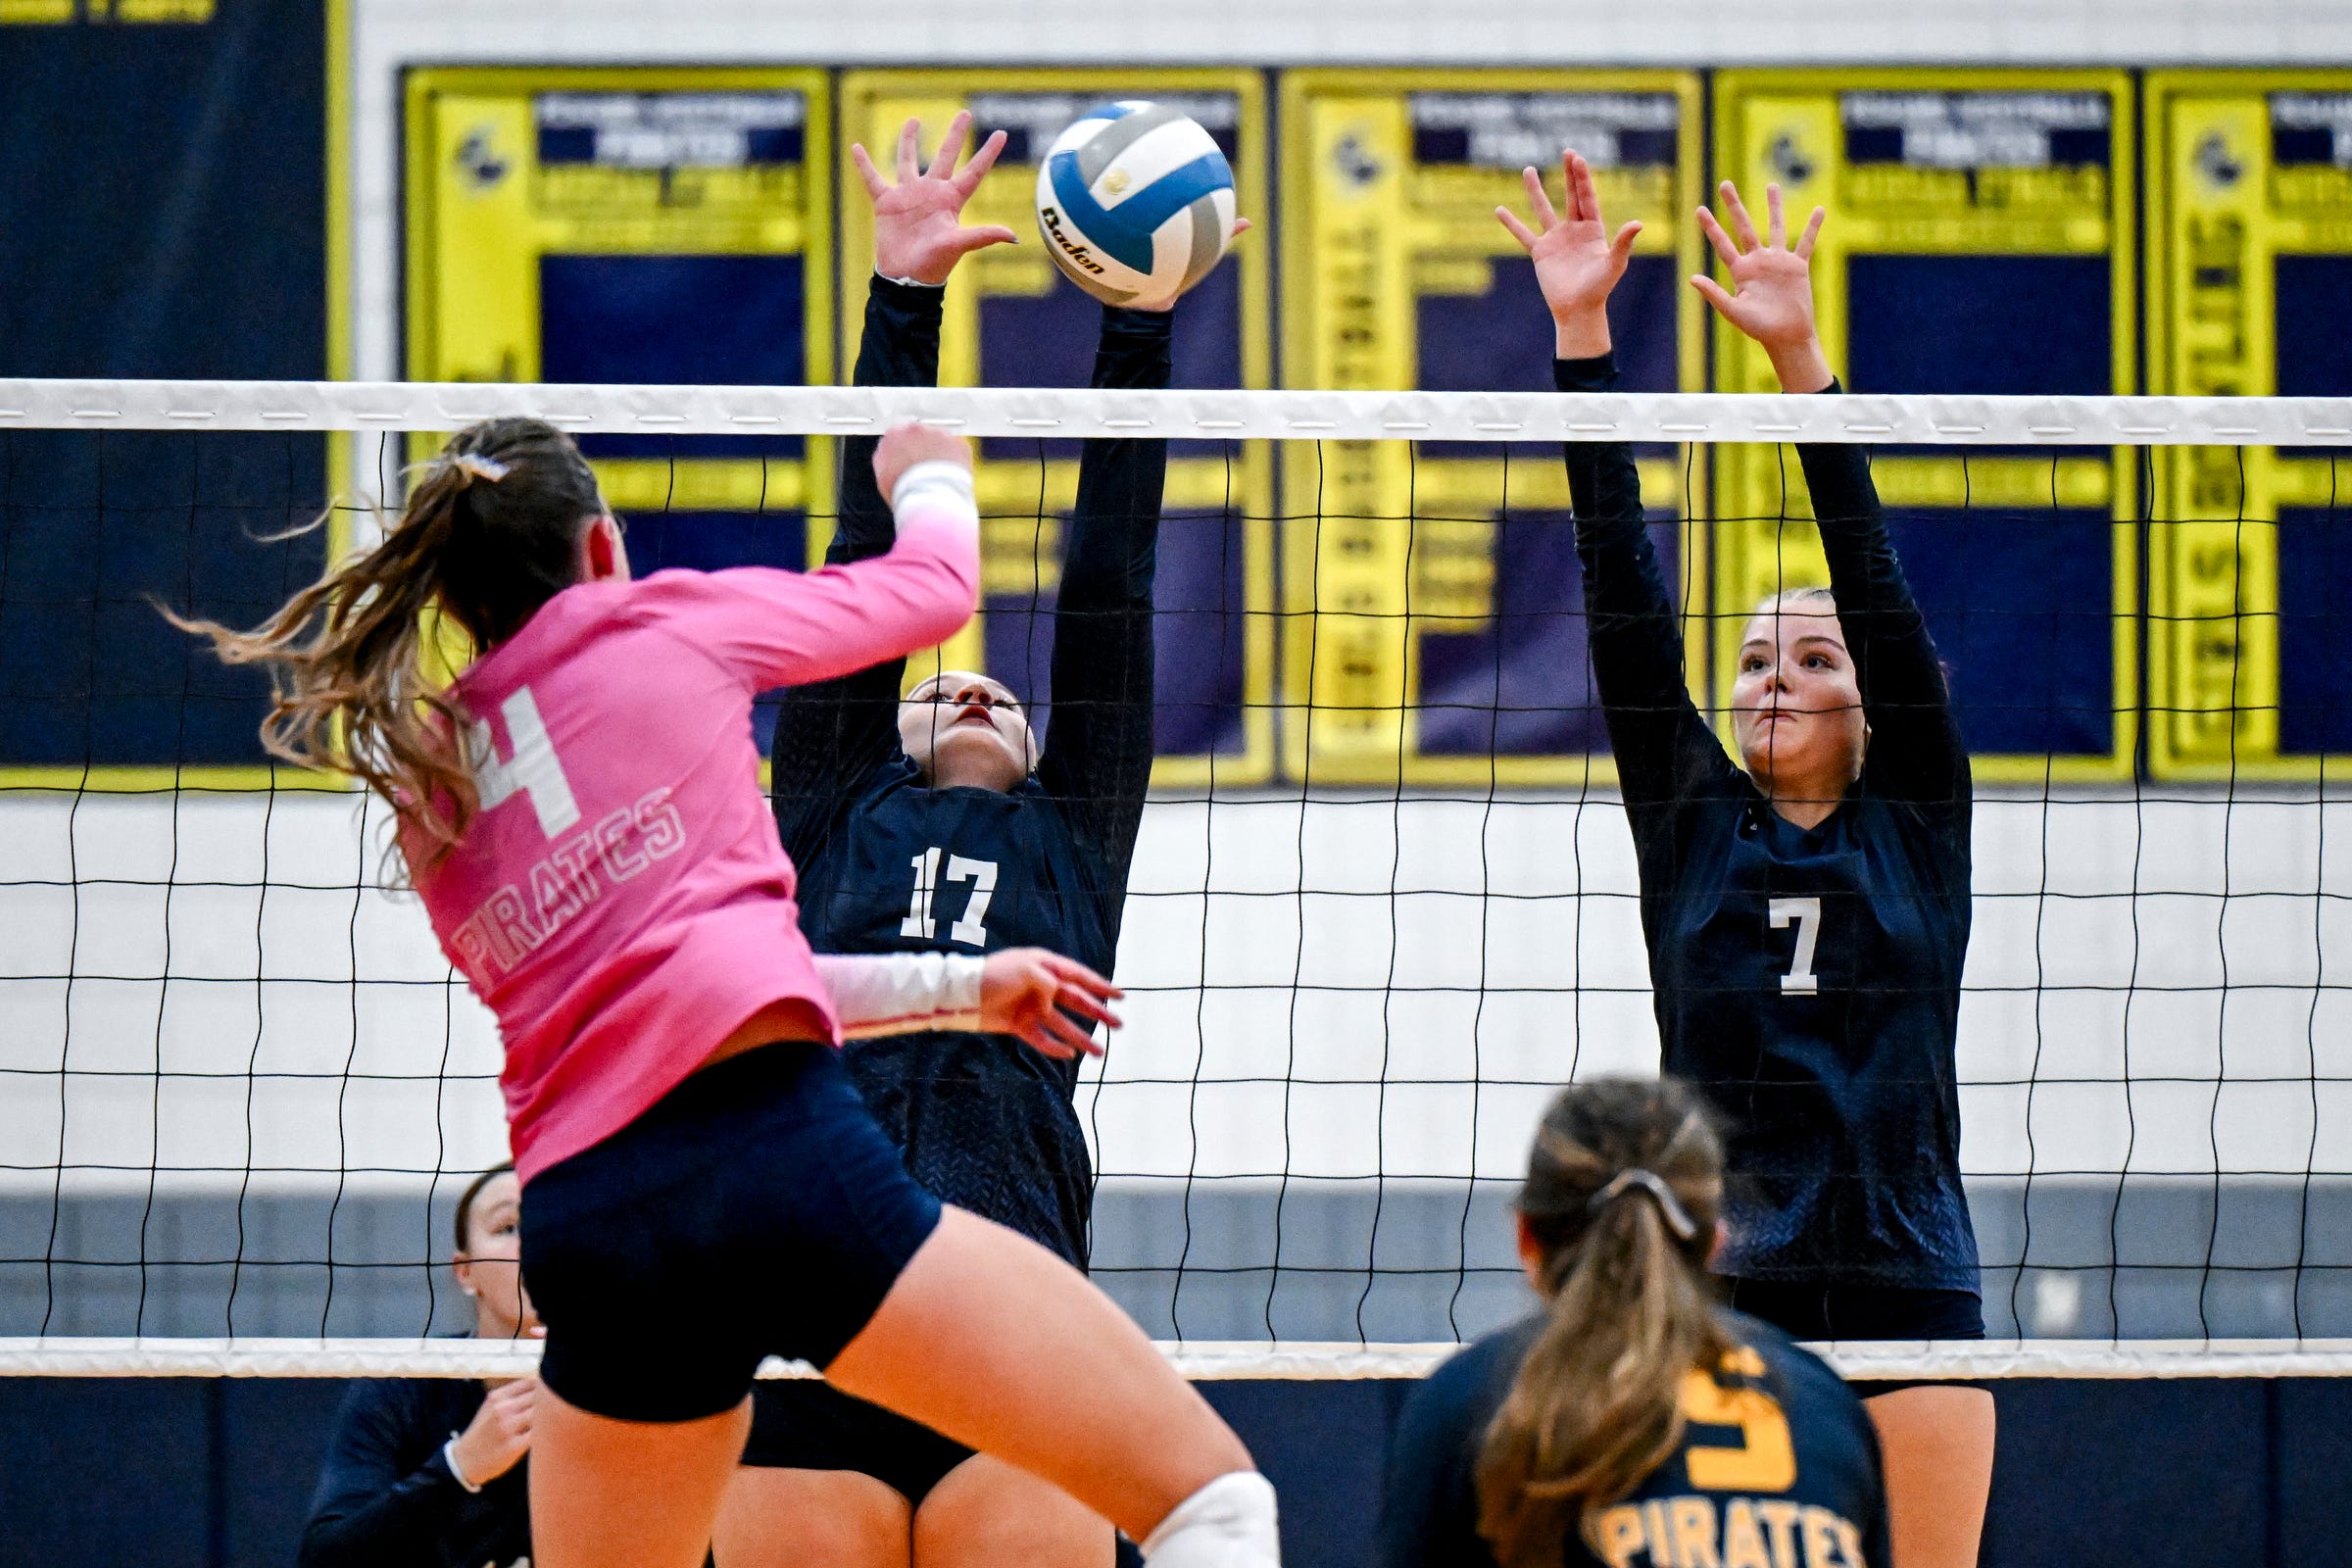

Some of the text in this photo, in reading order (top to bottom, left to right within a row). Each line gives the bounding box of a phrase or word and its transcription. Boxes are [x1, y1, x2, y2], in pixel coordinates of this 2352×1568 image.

[1041, 207, 1104, 274] Baden
[466, 684, 581, 840] 4
[450, 786, 687, 998] PIRATES
[900, 847, 998, 948] 17
[1768, 897, 1821, 996] 7
[1677, 1345, 1797, 1493] 5
